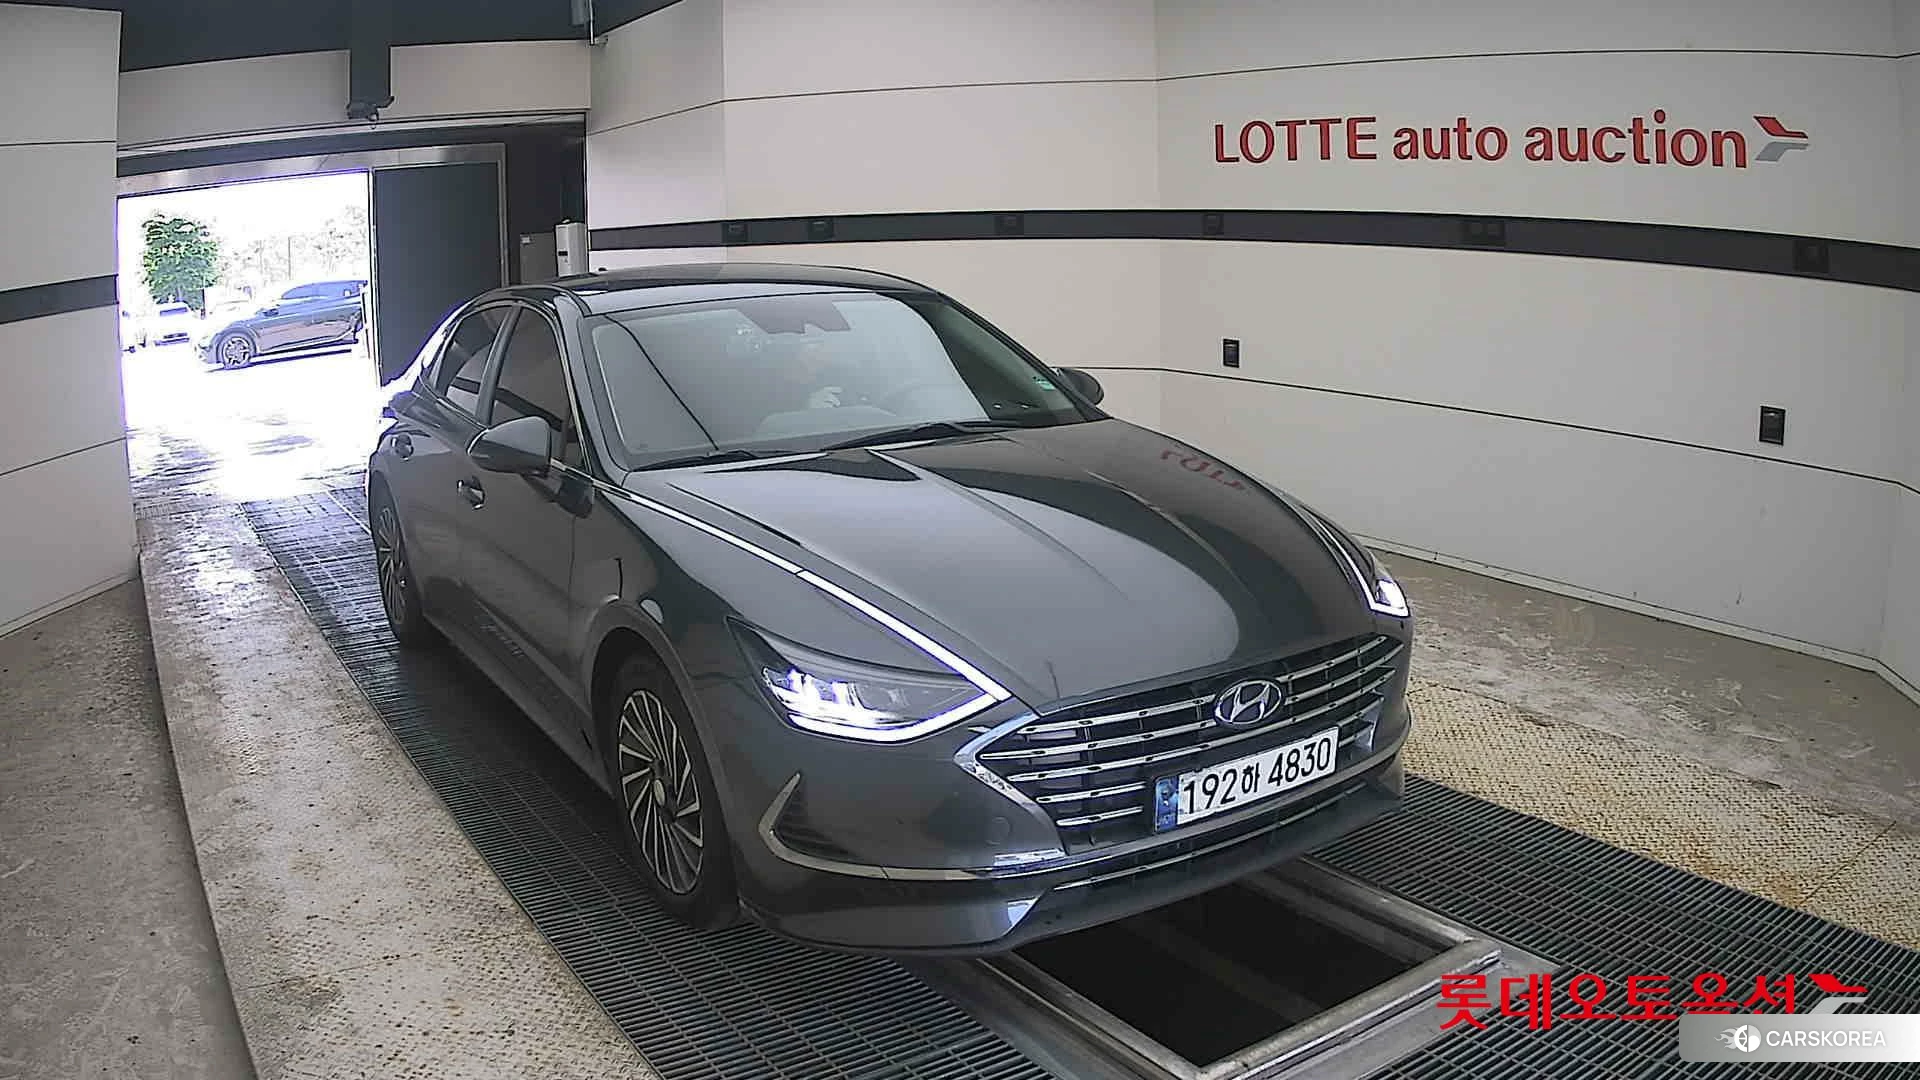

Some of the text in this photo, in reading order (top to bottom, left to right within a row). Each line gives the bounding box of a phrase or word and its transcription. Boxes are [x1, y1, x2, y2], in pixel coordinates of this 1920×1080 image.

[1214, 110, 1747, 168] LOTTE auto auction
[1183, 737, 1331, 815] 192하 4830
